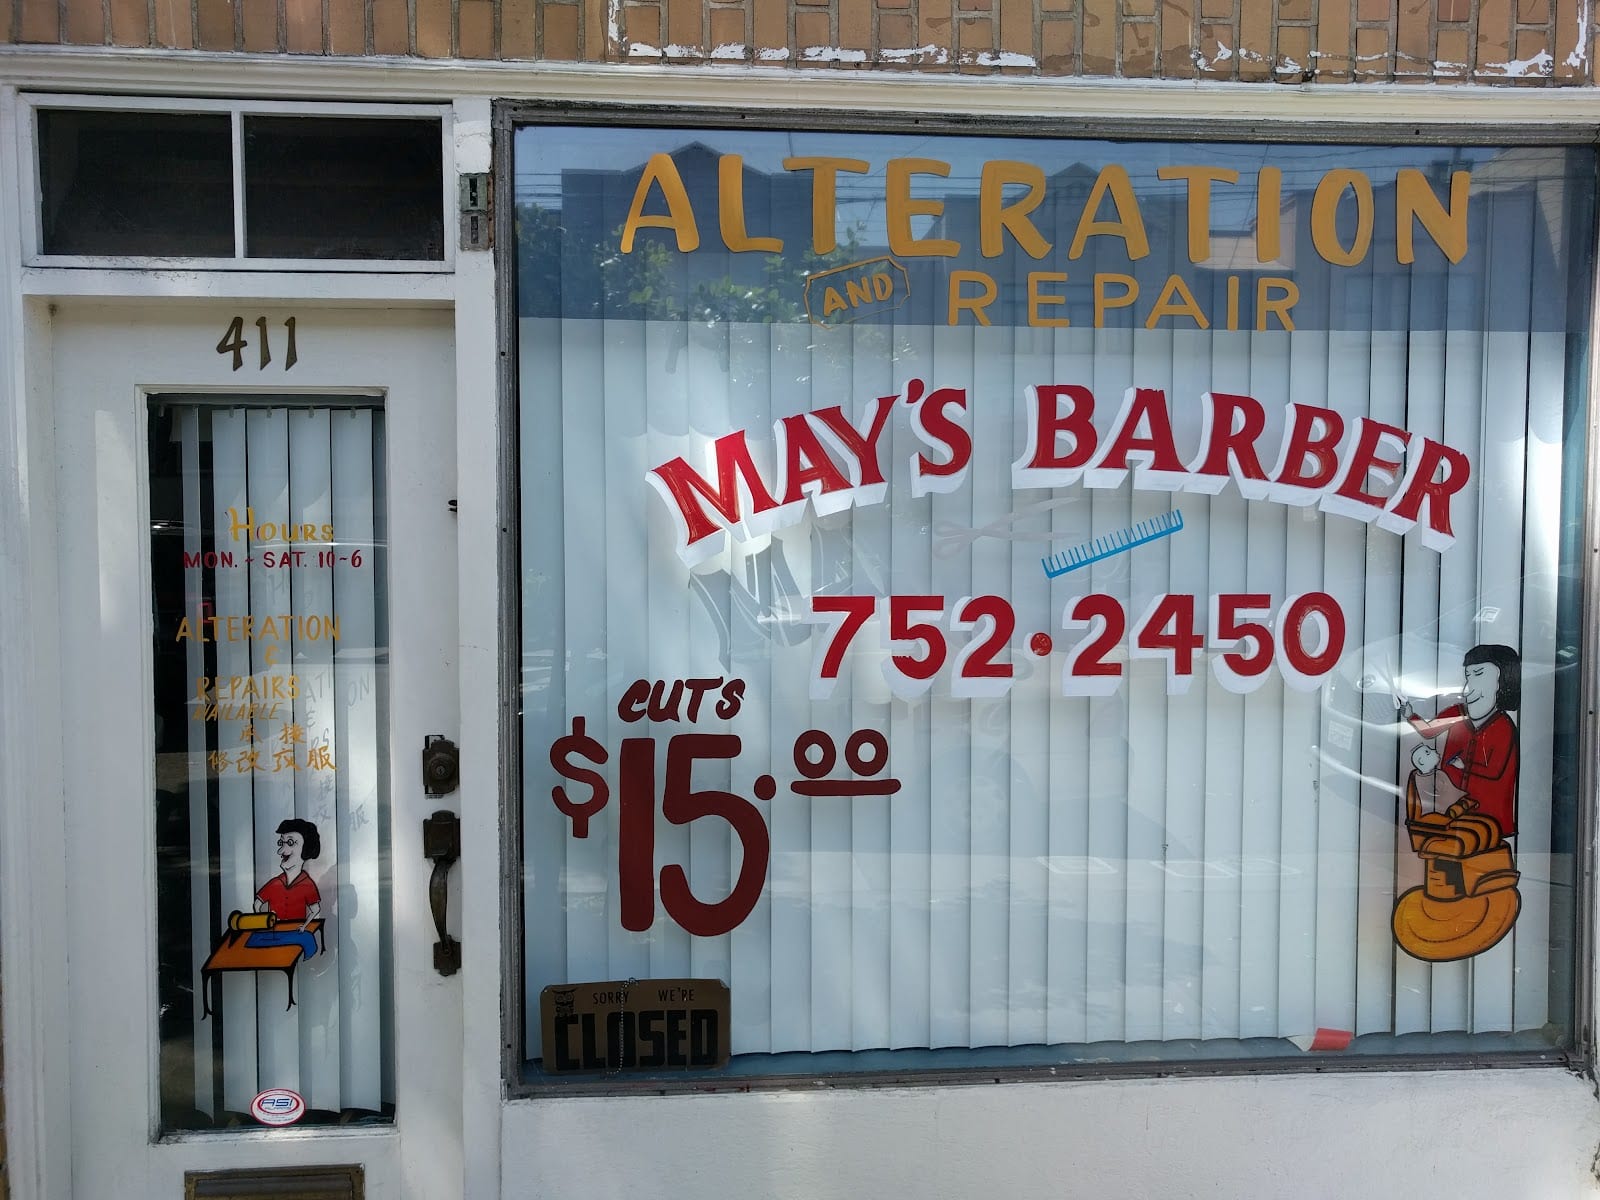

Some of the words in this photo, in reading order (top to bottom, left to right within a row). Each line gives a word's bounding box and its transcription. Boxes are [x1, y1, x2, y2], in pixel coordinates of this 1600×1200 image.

[620, 153, 1471, 267] ALTERATION
[822, 272, 894, 317] AND
[947, 270, 1300, 332] REPAIR
[216, 316, 298, 371] 411
[649, 378, 973, 550] MAY'S
[1022, 384, 1471, 543] BARBER
[183, 551, 238, 568] MON.
[263, 551, 307, 568] SAT.
[176, 615, 341, 642] ALTERATION
[196, 674, 300, 700] REPAIRS
[618, 676, 746, 724] CUTS
[192, 702, 284, 721] AVAILABLE
[593, 990, 630, 1005] SORRY
[658, 987, 695, 1002] WE'RE
[554, 1009, 718, 1071] CLOSED
[261, 1098, 293, 1107] ASI
